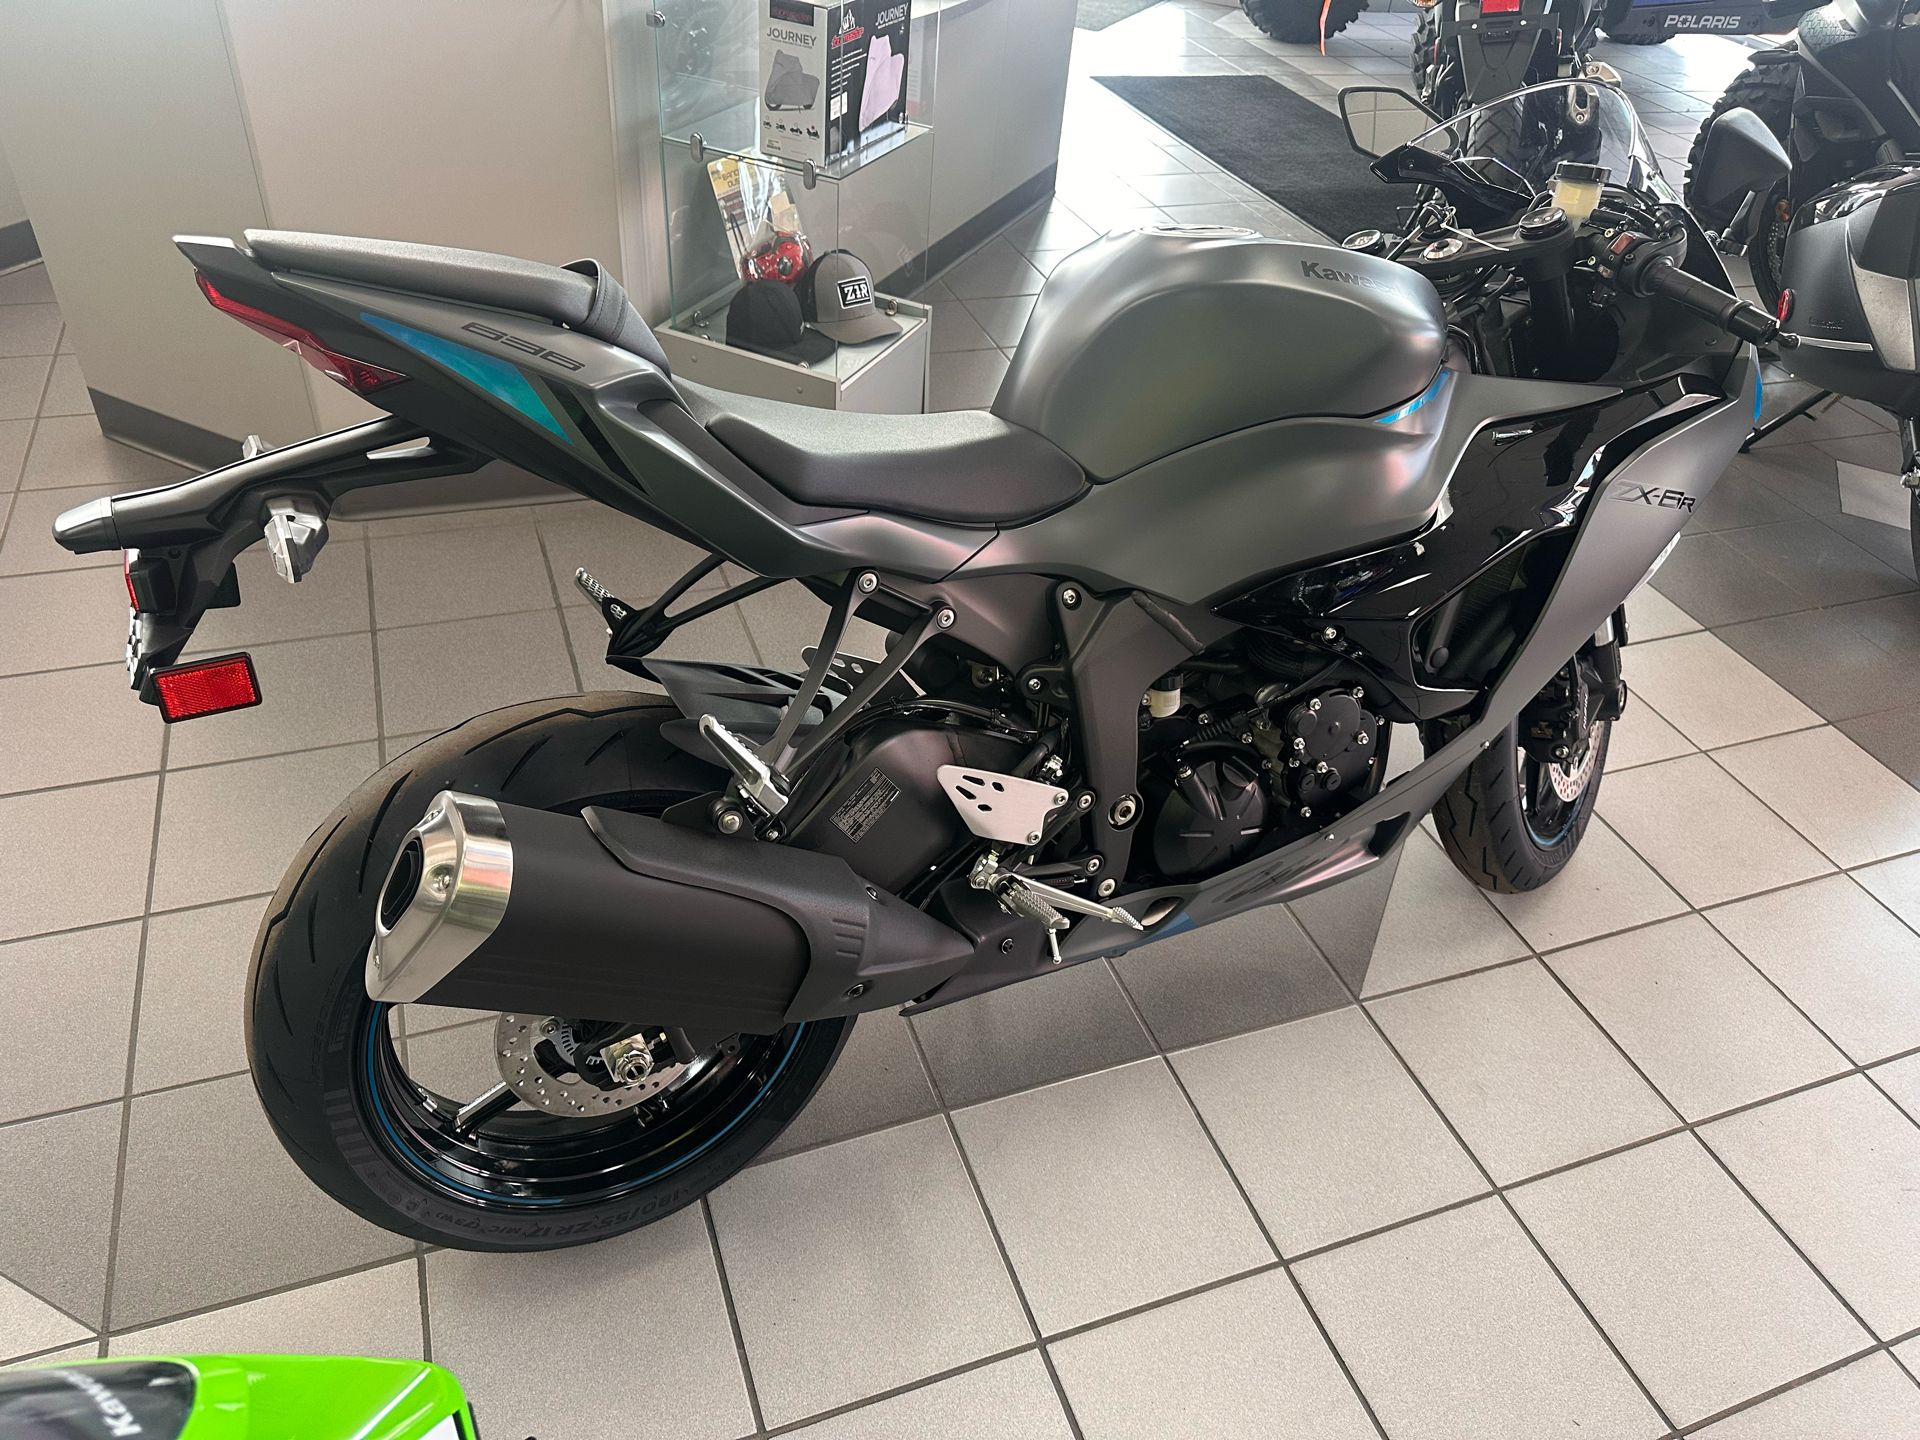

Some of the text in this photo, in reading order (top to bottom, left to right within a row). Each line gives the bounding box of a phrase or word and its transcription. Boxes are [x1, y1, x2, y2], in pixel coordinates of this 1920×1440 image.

[875, 3, 909, 26] JOURNEY
[1664, 15, 1741, 28] POLARIS
[766, 27, 817, 47] JOURNEY
[1608, 480, 1697, 513] ZX-6R
